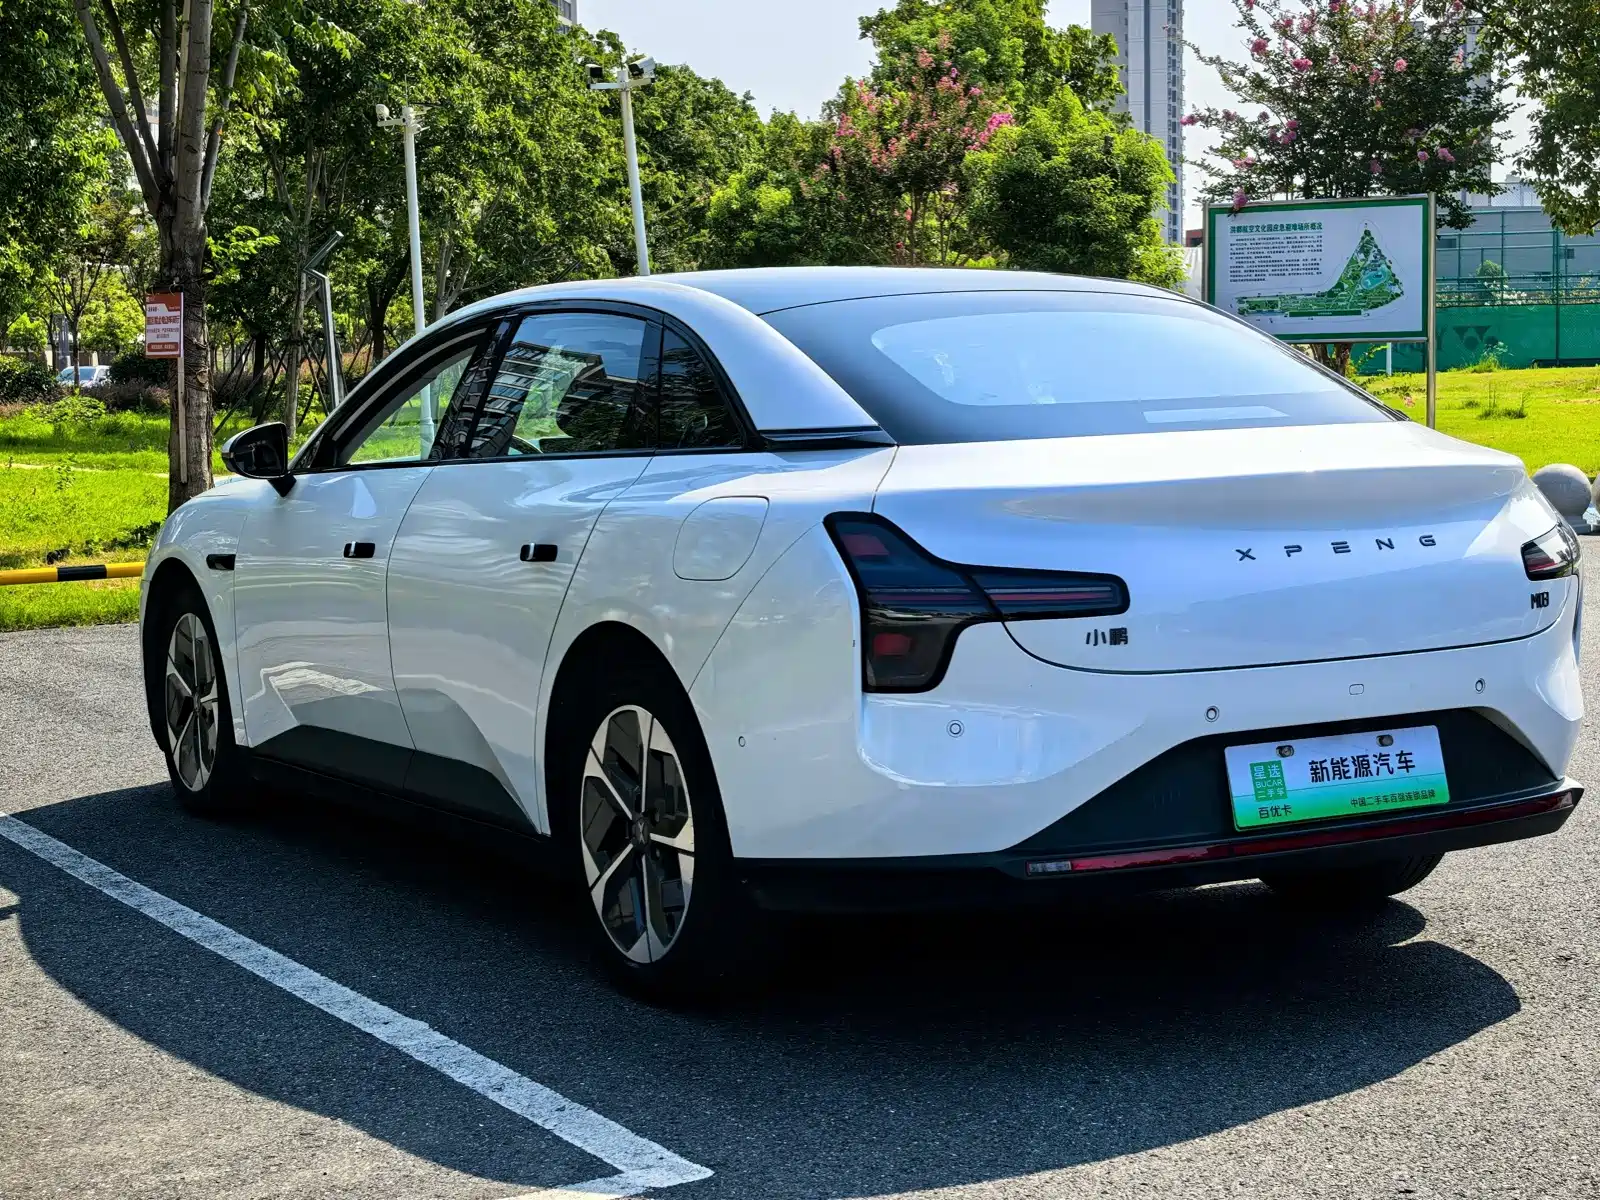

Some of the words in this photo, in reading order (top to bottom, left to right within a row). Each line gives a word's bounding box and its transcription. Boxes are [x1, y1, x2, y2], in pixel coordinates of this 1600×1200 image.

[1235, 534, 1437, 561] XPENG
[1085, 627, 1128, 647] 小鹏
[1253, 763, 1281, 780] 星选
[1308, 750, 1416, 783] 新能源汽车
[1255, 778, 1283, 789] BUCAR
[1257, 787, 1285, 798] 二手车
[1350, 788, 1436, 807] 中国二手车百强连锁品牌
[1258, 804, 1292, 819] 百优卡
